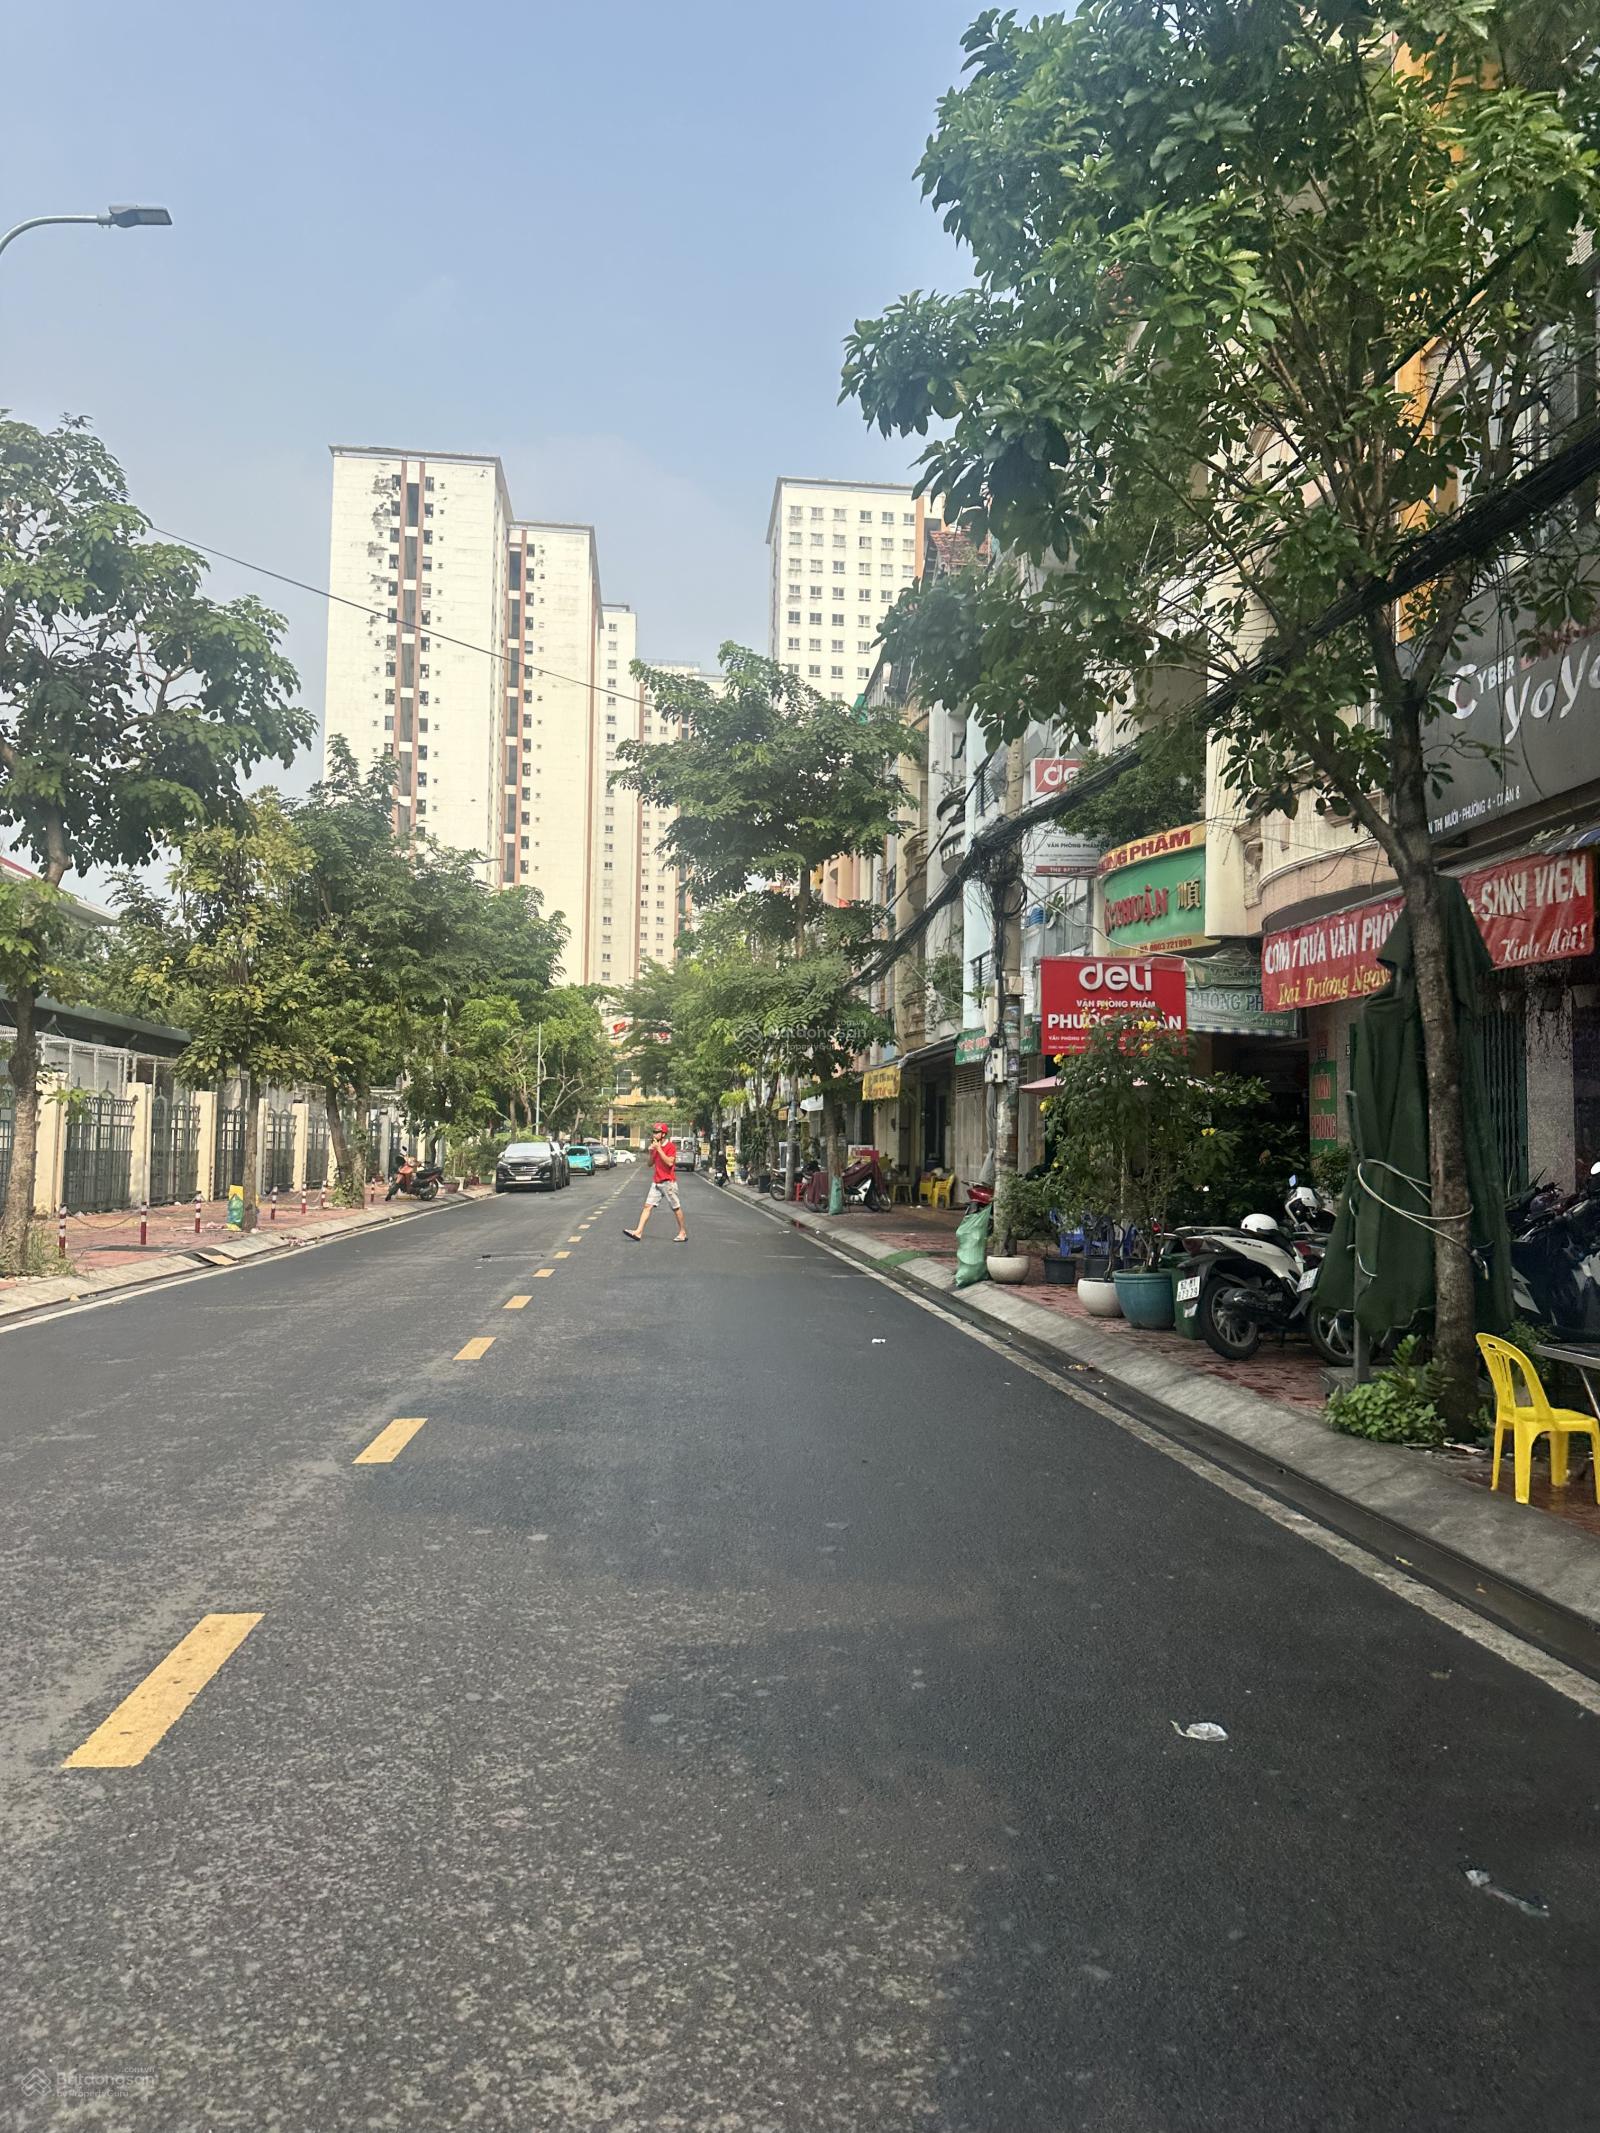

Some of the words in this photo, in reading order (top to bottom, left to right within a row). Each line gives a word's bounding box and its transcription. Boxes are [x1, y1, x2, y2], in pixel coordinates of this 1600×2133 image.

[1447, 655, 1515, 720] CYBER
[1480, 871, 1528, 921] SINH
[1078, 961, 1153, 991] deli
[1246, 994, 1264, 1012] PH
